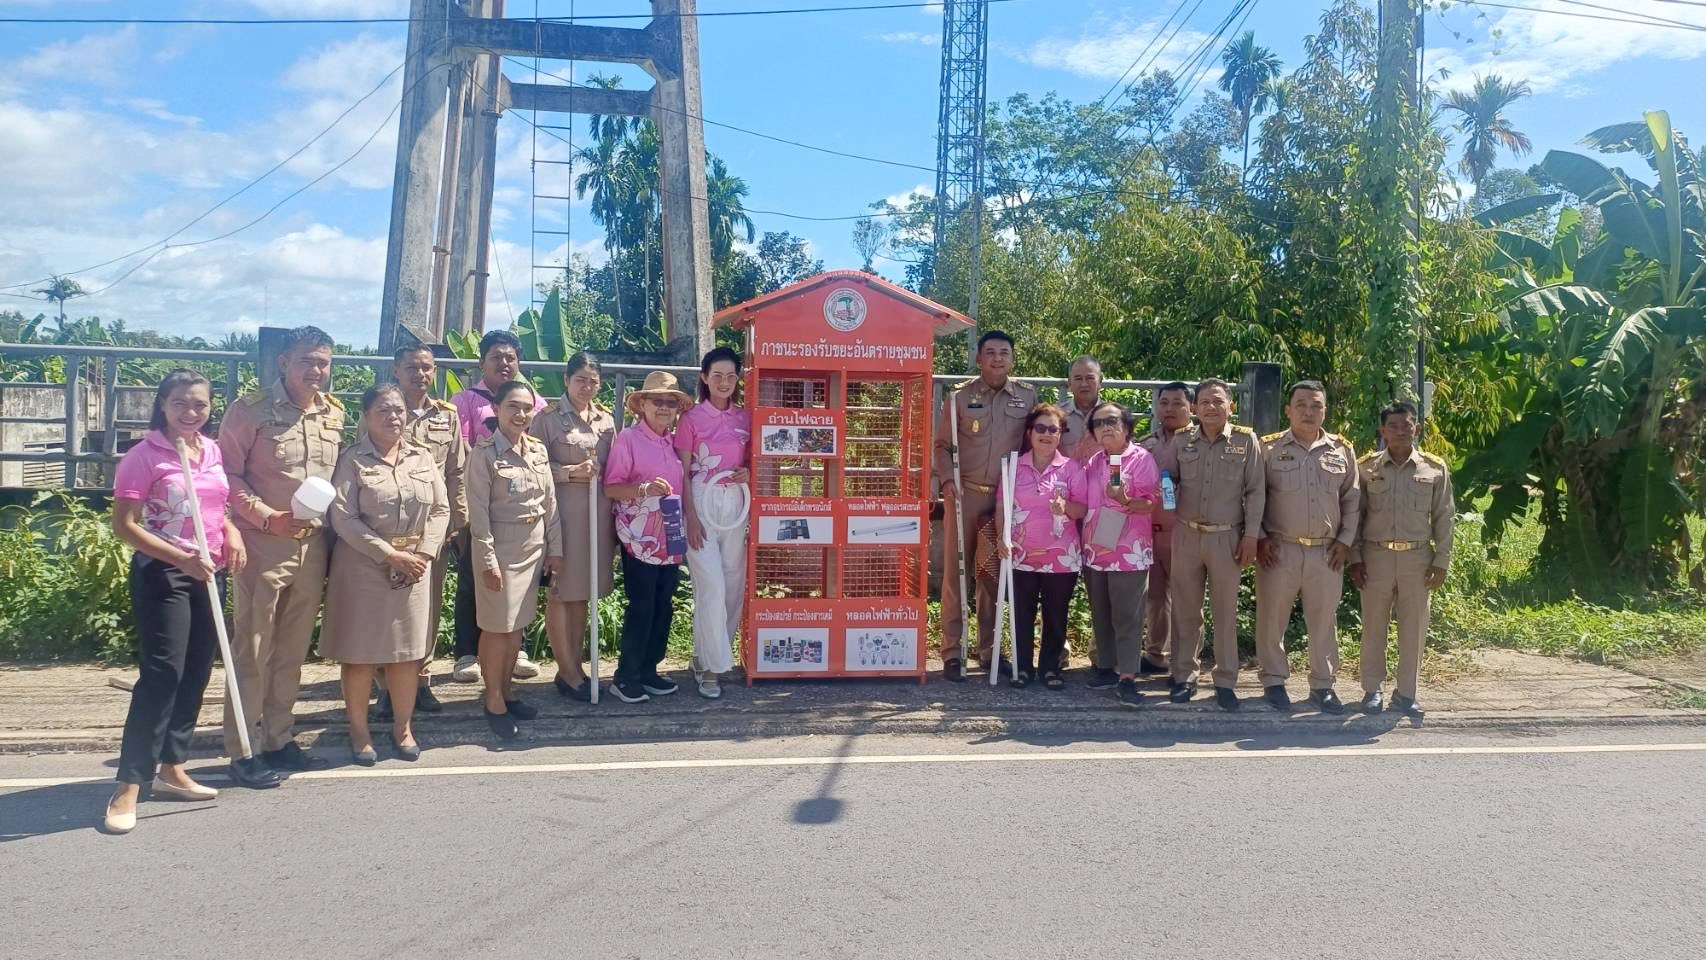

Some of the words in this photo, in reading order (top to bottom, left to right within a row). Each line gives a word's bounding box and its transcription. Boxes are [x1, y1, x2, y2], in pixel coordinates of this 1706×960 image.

[761, 338, 927, 366] ภาชนะรองรับขยะอันตรายชุมชน
[768, 411, 834, 425] ถ่านไฟฉาย
[846, 605, 918, 620] หลอดไฟฟ้าทั่วไป
